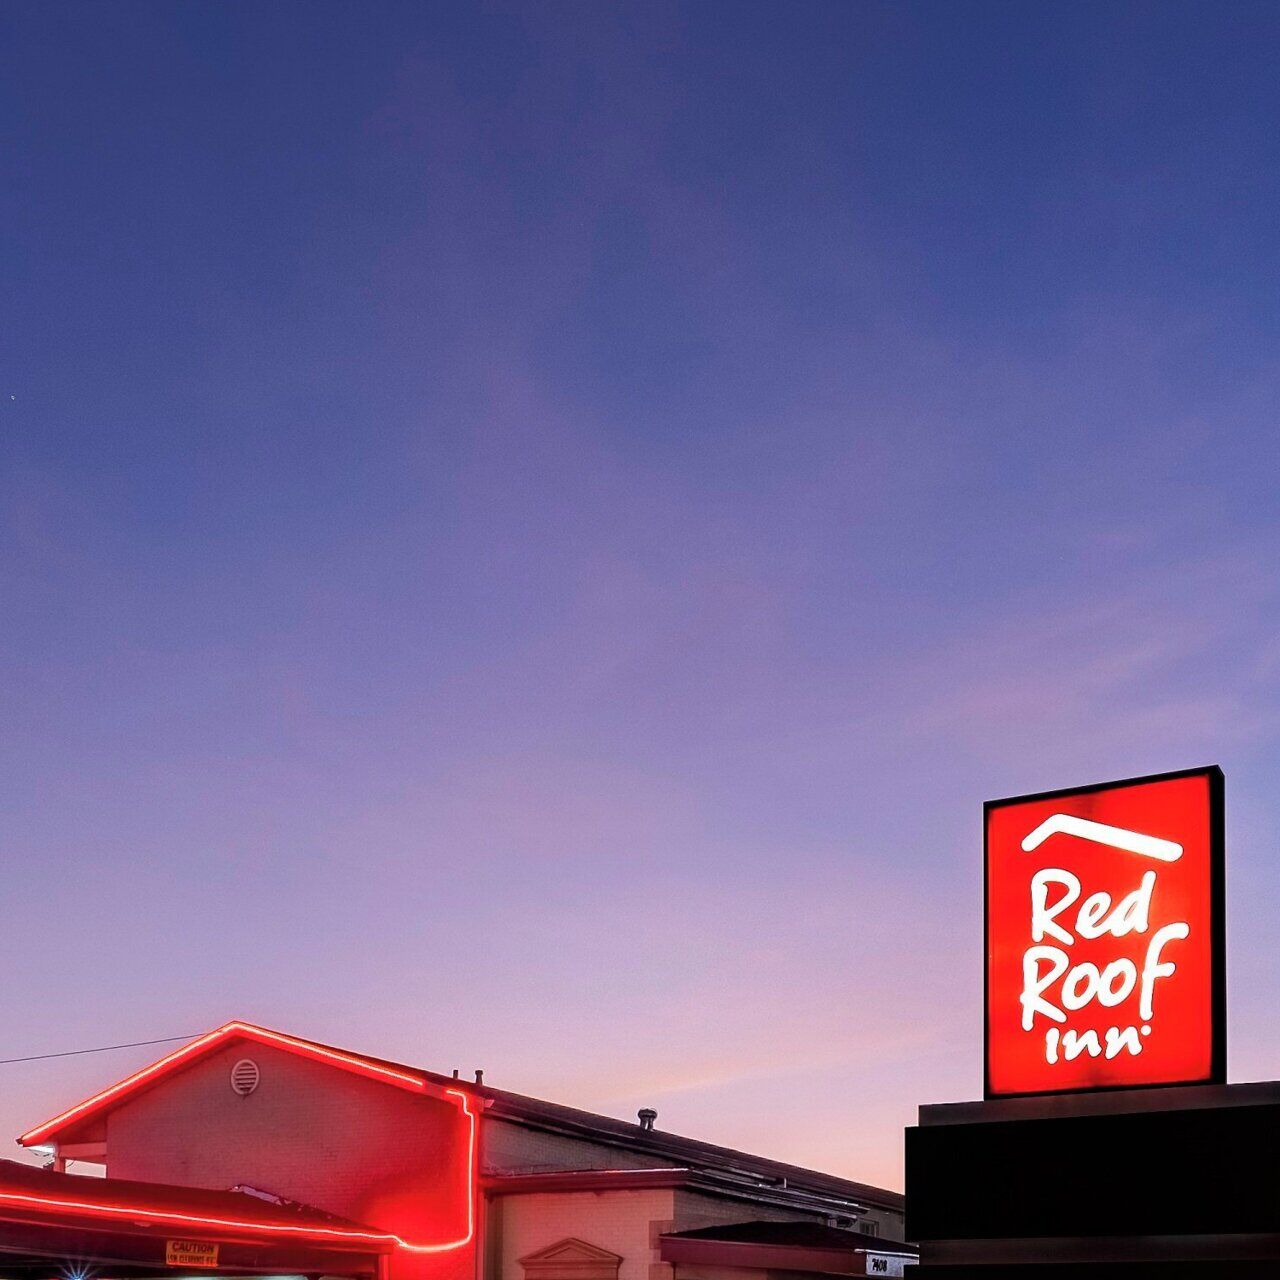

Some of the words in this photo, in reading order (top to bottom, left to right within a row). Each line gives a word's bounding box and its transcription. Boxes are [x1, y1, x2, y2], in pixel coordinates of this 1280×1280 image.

[1031, 868, 1157, 946] Red
[1019, 922, 1190, 1032] Roof
[172, 1241, 215, 1254] CAUTION
